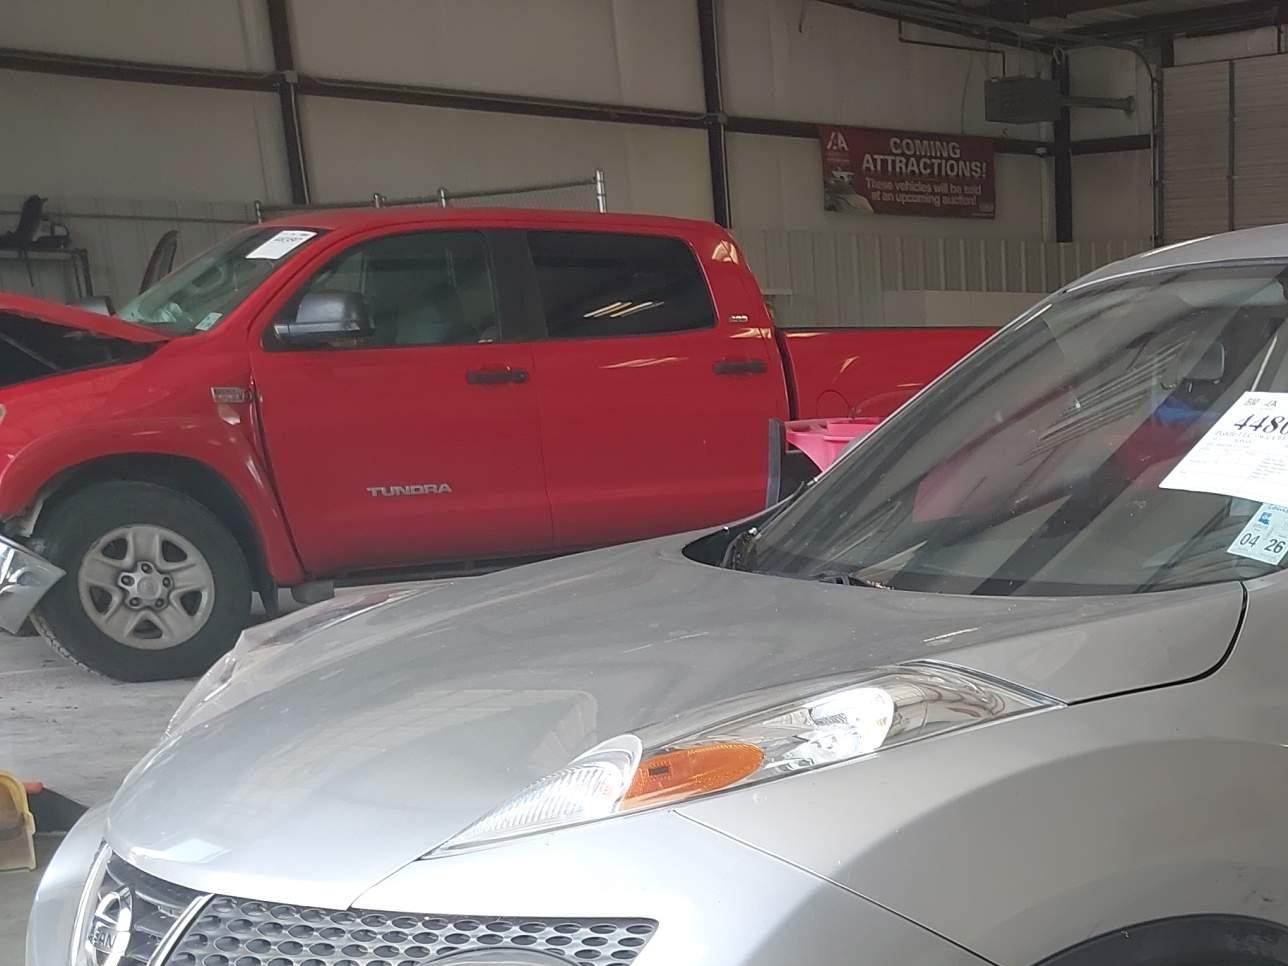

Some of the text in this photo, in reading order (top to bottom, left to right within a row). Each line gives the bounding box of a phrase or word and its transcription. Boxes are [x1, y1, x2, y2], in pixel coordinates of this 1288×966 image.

[889, 137, 961, 158] COMING
[862, 153, 987, 178] ATTRACTIONS!
[895, 180, 932, 193] vehicles
[933, 182, 949, 194] will
[366, 483, 452, 497] TUNDRA
[1240, 533, 1286, 554] 04 26
